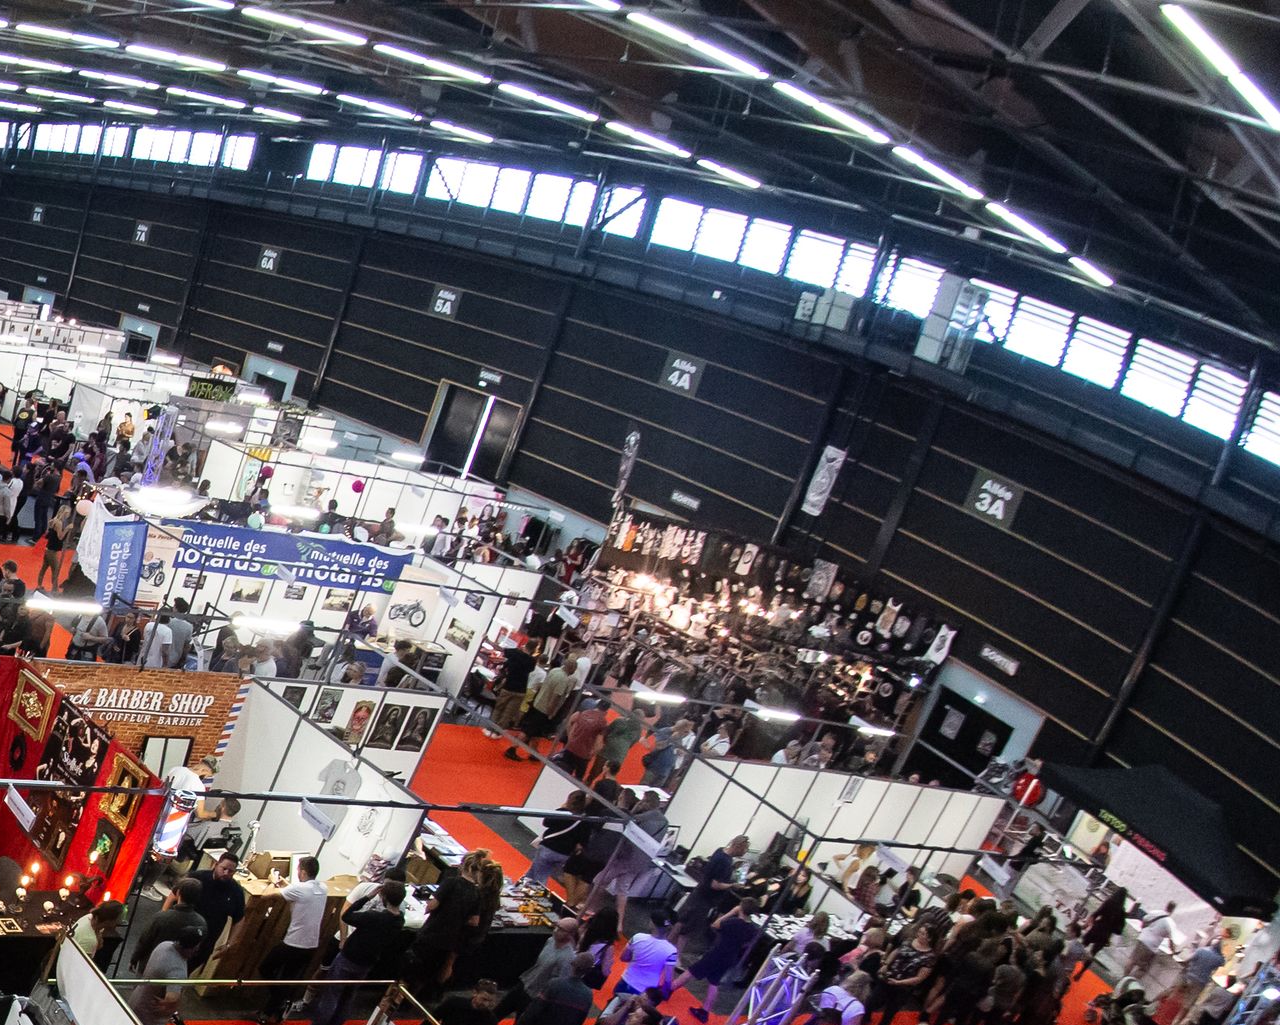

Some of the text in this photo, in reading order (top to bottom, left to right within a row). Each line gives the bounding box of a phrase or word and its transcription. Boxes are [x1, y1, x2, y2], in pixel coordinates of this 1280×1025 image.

[135, 231, 146, 242] 7A
[260, 257, 274, 271] 6A
[434, 299, 452, 315] 5A
[667, 370, 691, 390] 4A
[980, 479, 1014, 502] Allée
[974, 492, 1006, 520] 3A
[182, 533, 267, 554] mutuelle des
[310, 550, 390, 569] mutuelle des
[94, 688, 164, 712] BARBER
[168, 693, 216, 715] SHOP
[98, 712, 152, 724] COIFFEUR
[157, 717, 204, 728] BARBIER
